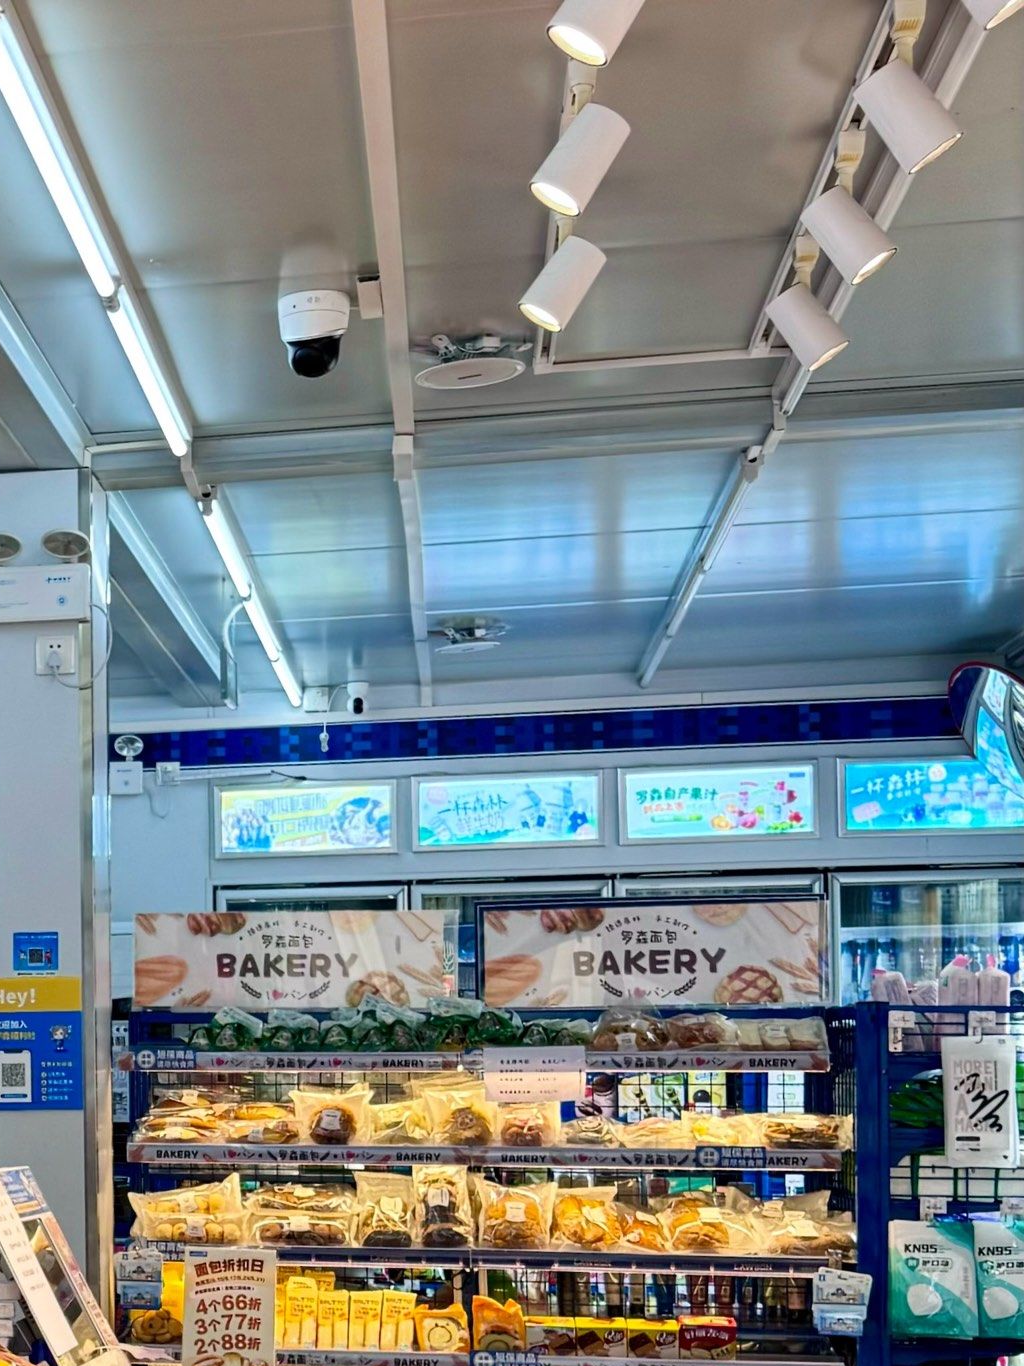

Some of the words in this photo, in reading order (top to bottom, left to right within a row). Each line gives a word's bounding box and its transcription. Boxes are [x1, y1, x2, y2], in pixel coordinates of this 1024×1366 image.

[262, 934, 313, 948] 罗森面包
[621, 928, 677, 945] 罗森面包
[216, 953, 358, 978] BAKERY
[573, 948, 726, 977] BAKERY
[749, 1058, 797, 1069] BAKERY
[953, 1060, 993, 1076] MORE
[156, 1150, 199, 1160] BAKERY
[396, 1152, 441, 1162] BAKERY
[501, 1154, 547, 1164] BAKERY
[768, 1157, 808, 1167] AKERY
[904, 1244, 938, 1254] KN95
[978, 1246, 1013, 1256] KN95
[194, 1258, 264, 1278] 面包折扣日
[196, 1294, 262, 1315] 4个66折
[194, 1313, 261, 1335] 3个77折
[194, 1333, 261, 1355] 2个88折
